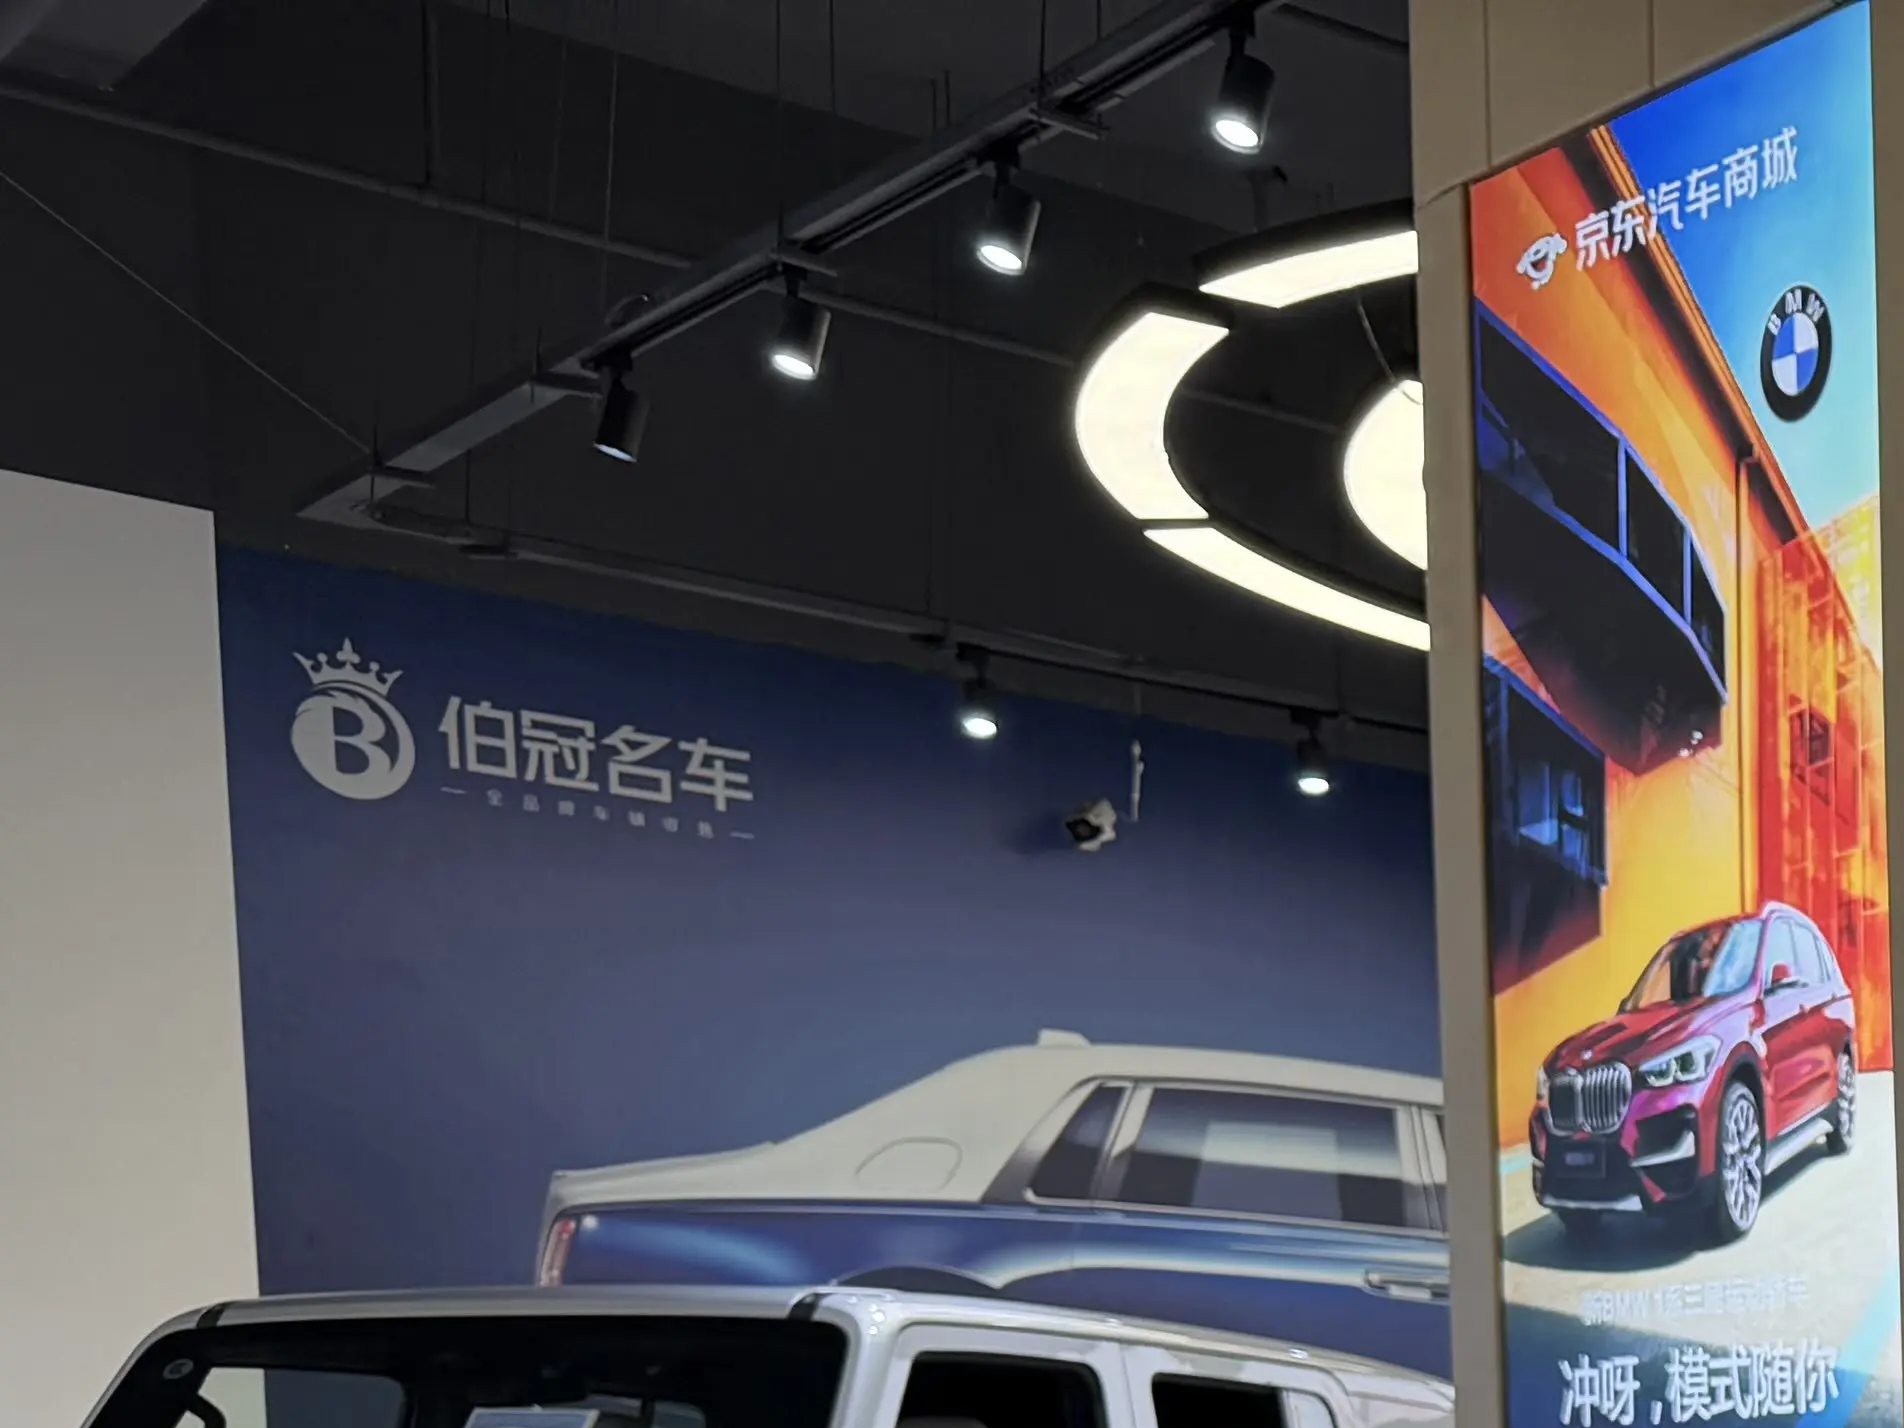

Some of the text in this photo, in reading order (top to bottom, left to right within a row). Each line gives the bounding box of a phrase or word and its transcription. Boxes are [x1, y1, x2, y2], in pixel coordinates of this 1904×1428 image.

[1575, 126, 1799, 273] 京东汽车商城
[1767, 289, 1825, 337] BMW
[438, 695, 755, 812] 伯冠名车
